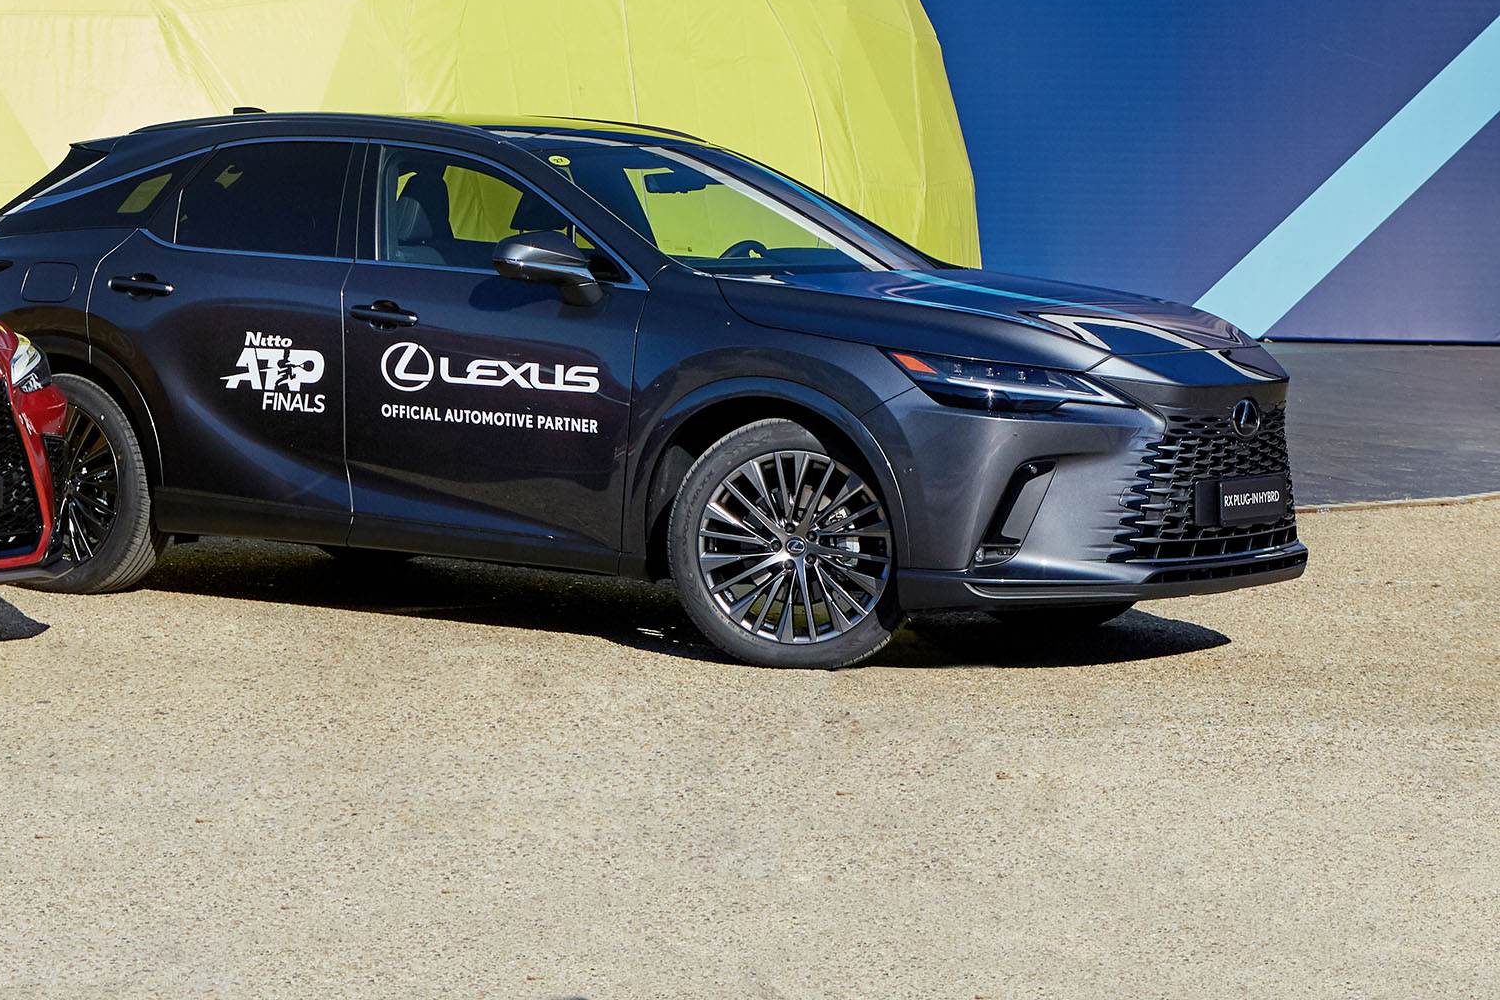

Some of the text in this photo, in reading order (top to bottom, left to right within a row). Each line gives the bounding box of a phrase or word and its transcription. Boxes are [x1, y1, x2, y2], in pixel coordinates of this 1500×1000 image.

[244, 331, 293, 347] Nitto
[219, 347, 325, 391] ATP
[439, 357, 600, 394] LEXUS
[262, 392, 326, 414] FINALS
[381, 403, 598, 434] OFFICIAL AUTOMOTIVE PARTNER
[1224, 494, 1234, 507] RX
[1234, 492, 1259, 506] PLUG-IN
